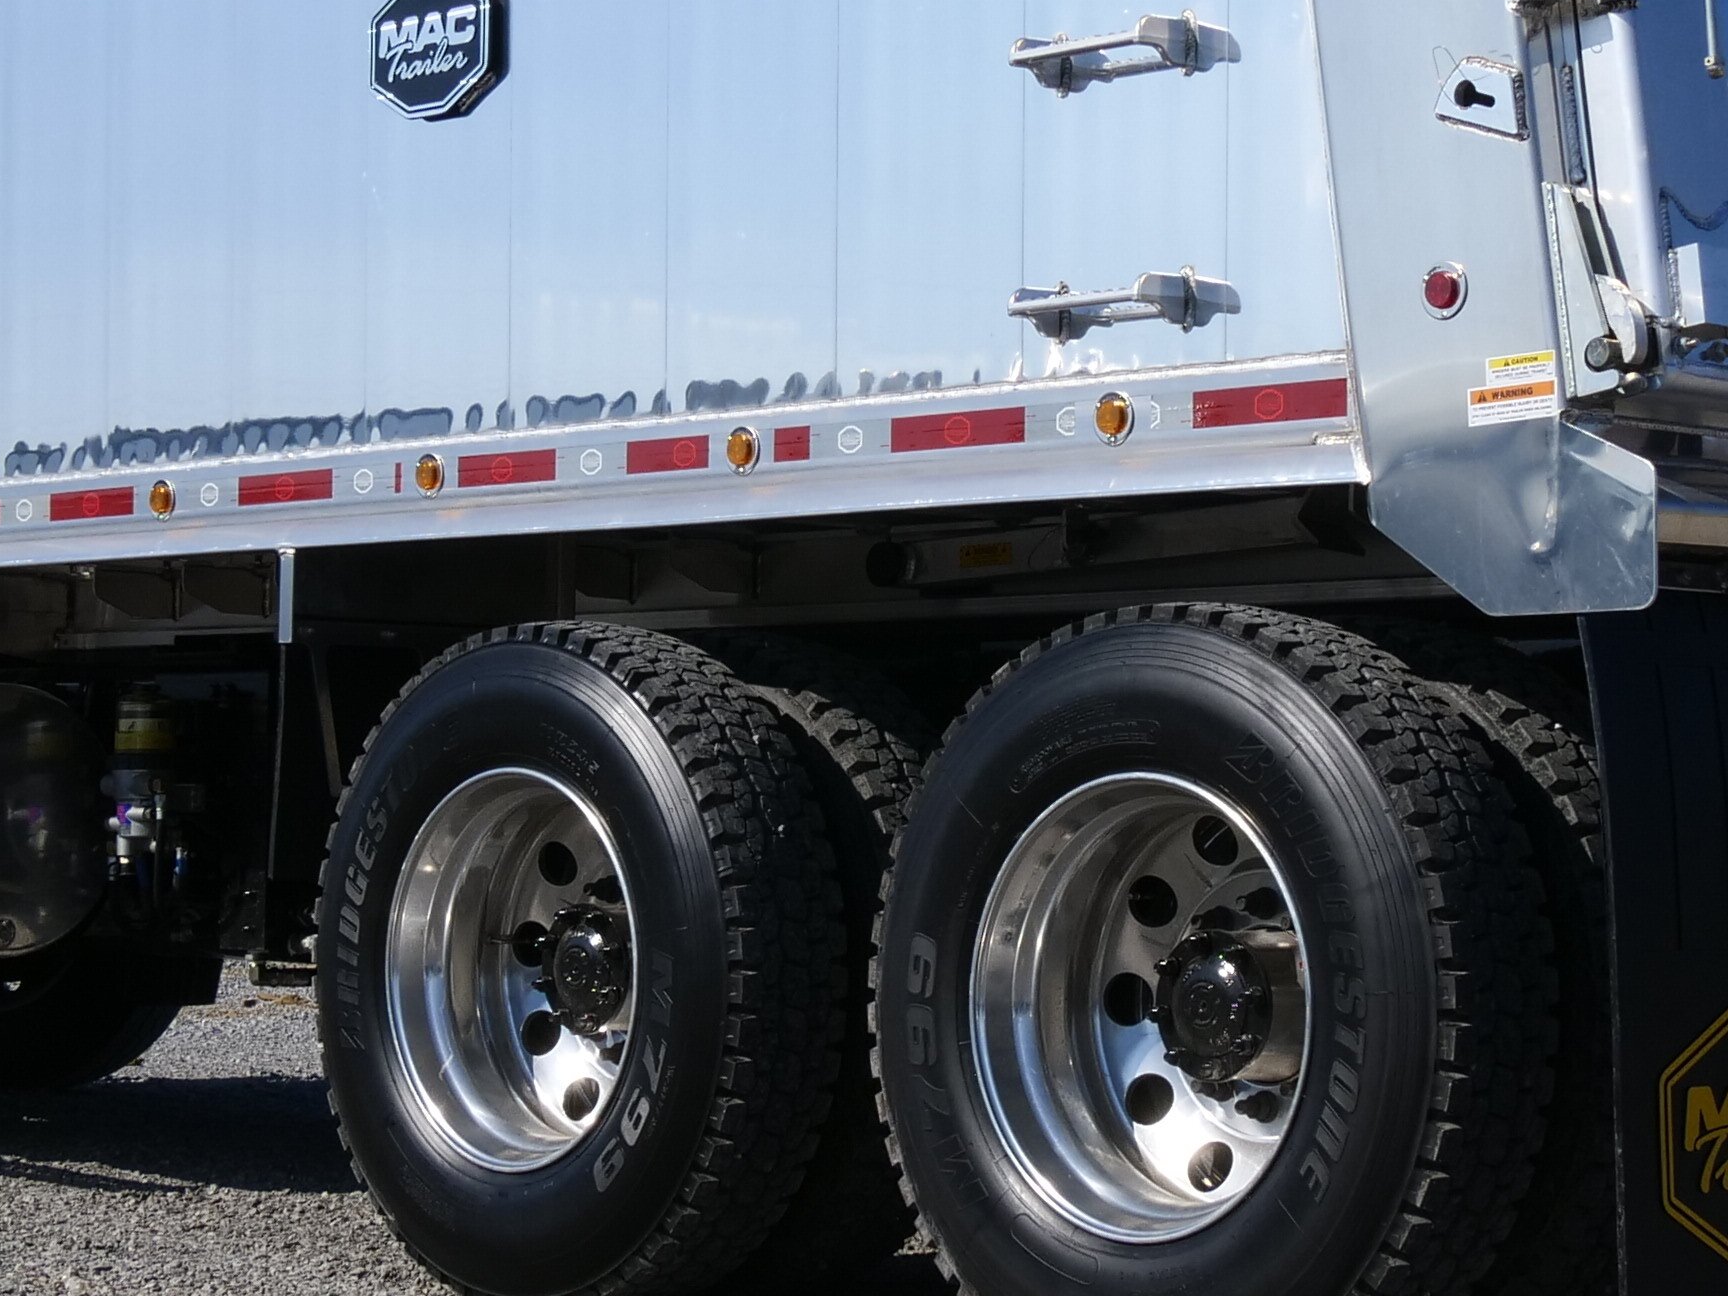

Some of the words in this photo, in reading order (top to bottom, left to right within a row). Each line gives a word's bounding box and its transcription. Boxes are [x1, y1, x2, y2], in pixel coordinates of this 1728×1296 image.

[378, 4, 477, 59] MAC
[385, 38, 469, 83] Trailer
[1511, 356, 1539, 365] CAUTION
[1491, 386, 1534, 400] WARNING
[1224, 730, 1367, 1204] BRIDGESTONE
